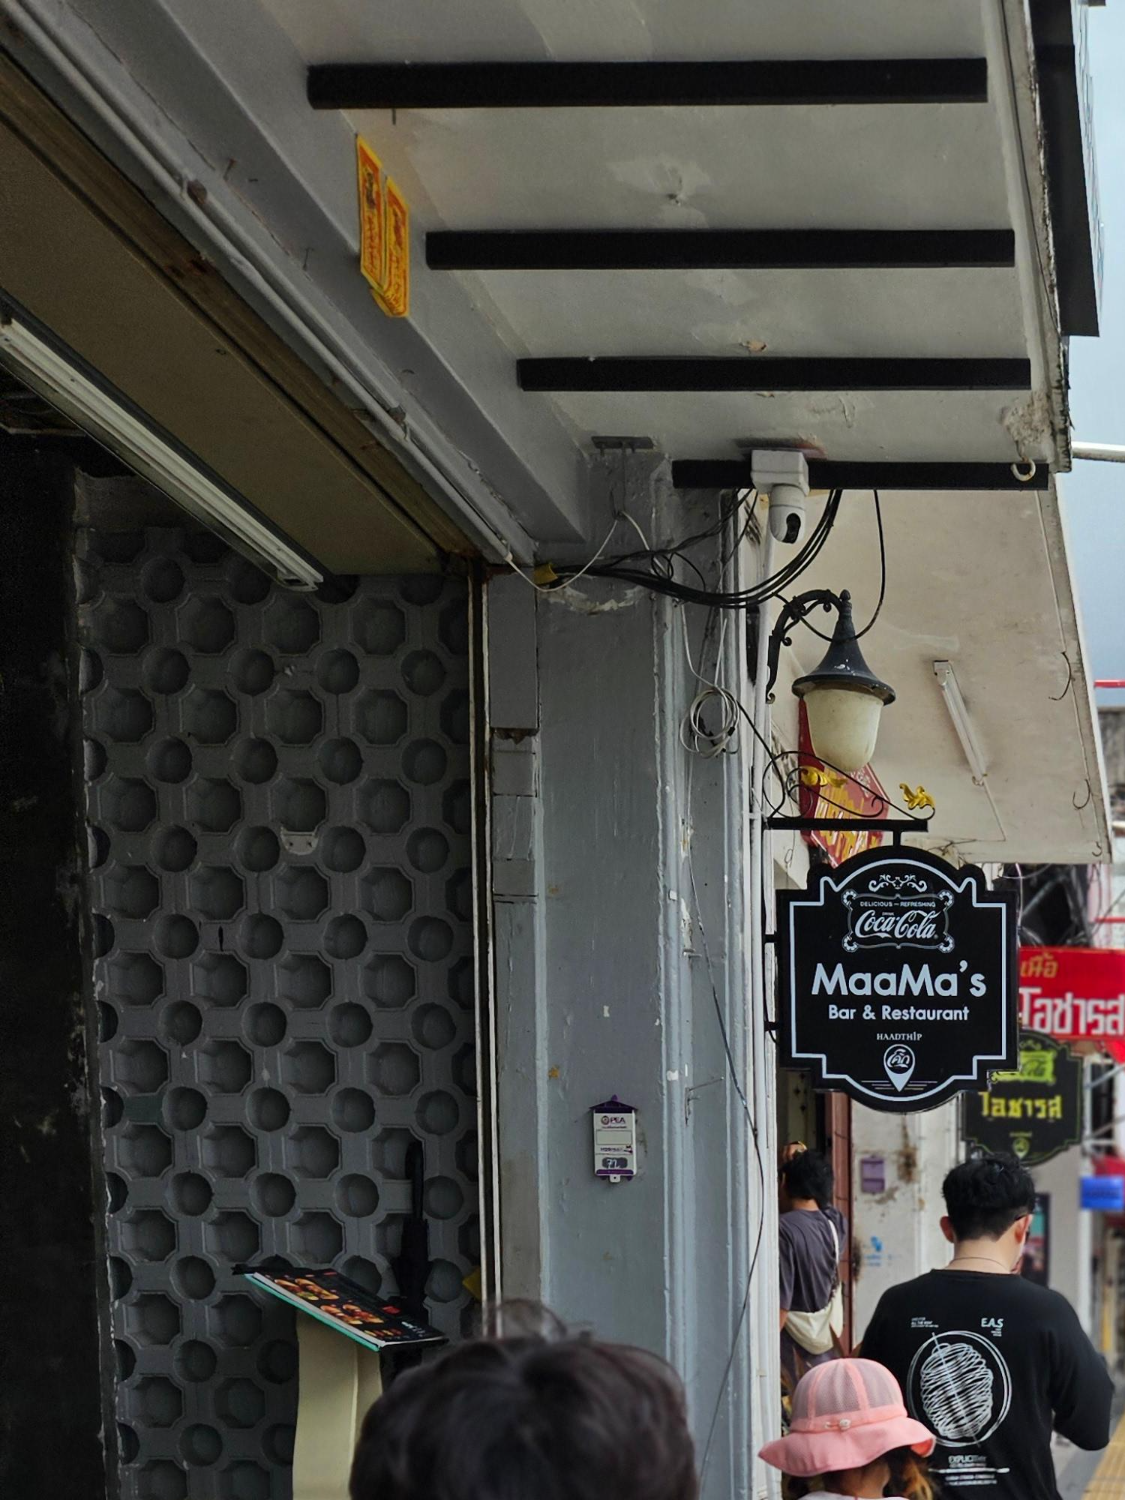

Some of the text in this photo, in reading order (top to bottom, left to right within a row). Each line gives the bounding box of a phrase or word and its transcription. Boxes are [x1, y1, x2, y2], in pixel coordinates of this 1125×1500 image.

[855, 909, 942, 939] Coca-Cola
[811, 960, 986, 998] MaaMa's
[829, 1005, 970, 1021] Bar & Restaurant
[876, 1031, 923, 1041] HAADTHIP
